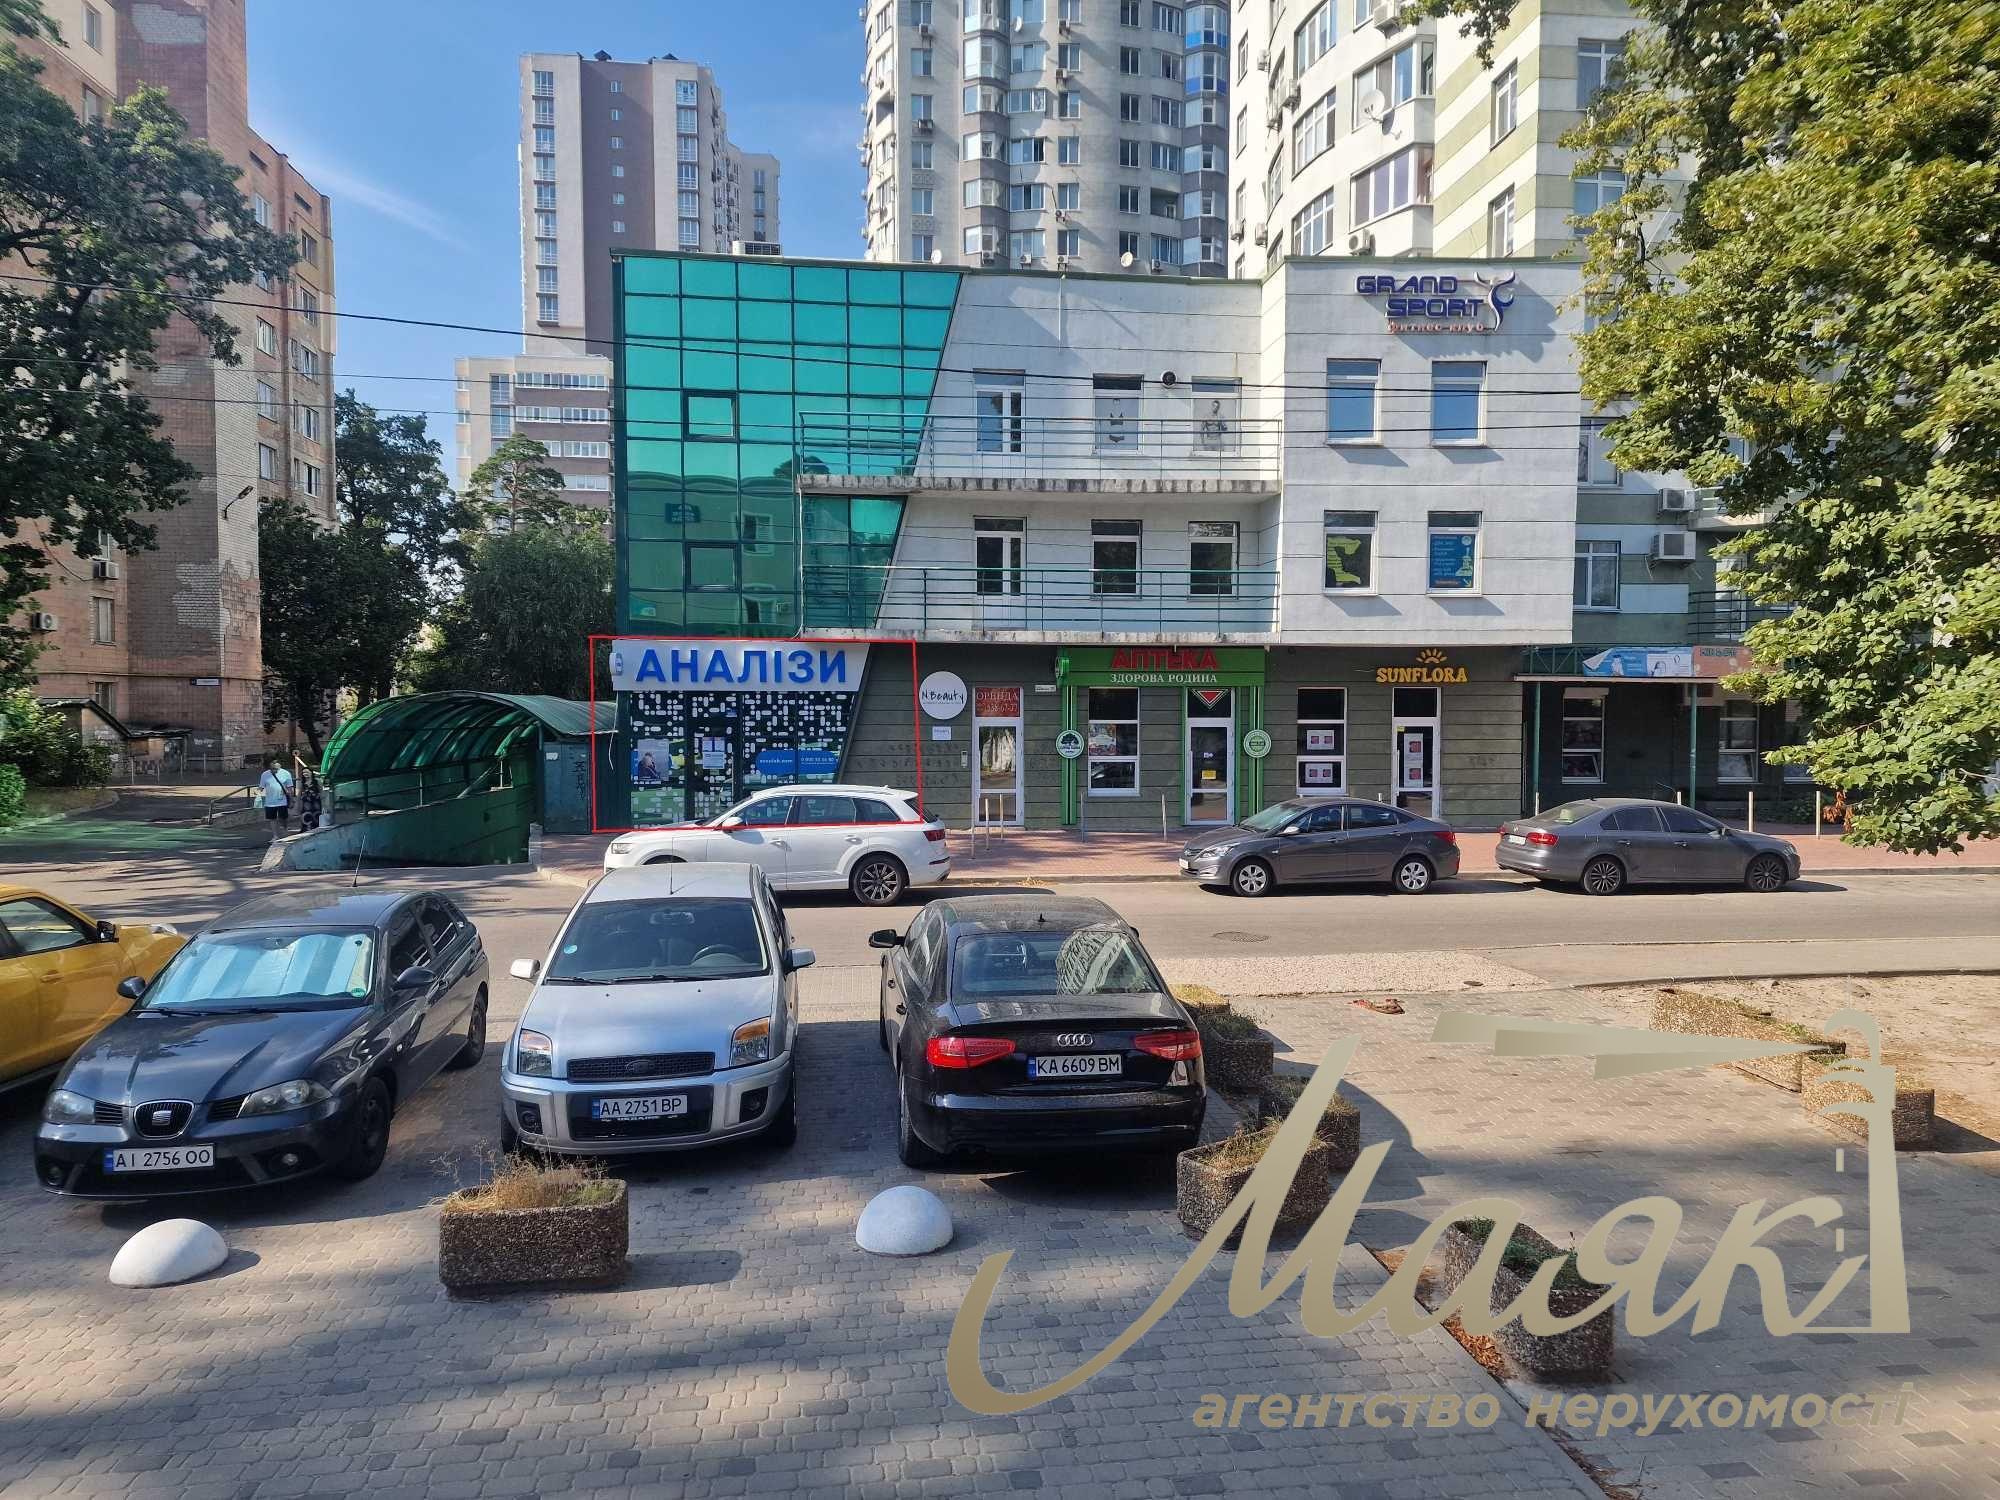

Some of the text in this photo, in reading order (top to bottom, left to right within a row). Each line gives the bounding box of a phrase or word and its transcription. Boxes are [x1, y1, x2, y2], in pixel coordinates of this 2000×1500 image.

[1356, 275, 1458, 294] GRAND
[1385, 297, 1484, 318] SPORT
[635, 649, 846, 684] АНАЛІЗИ
[1111, 646, 1218, 670] АПТЕКА
[1110, 673, 1218, 684] ЗДОРОВА РОДИНА
[1375, 667, 1468, 683] SUNFLORA
[1037, 1057, 1120, 1073] KA 6609 BM
[600, 1098, 682, 1115] AA 2751 BP
[116, 1153, 135, 1167] AI
[143, 1151, 181, 1166] 2756
